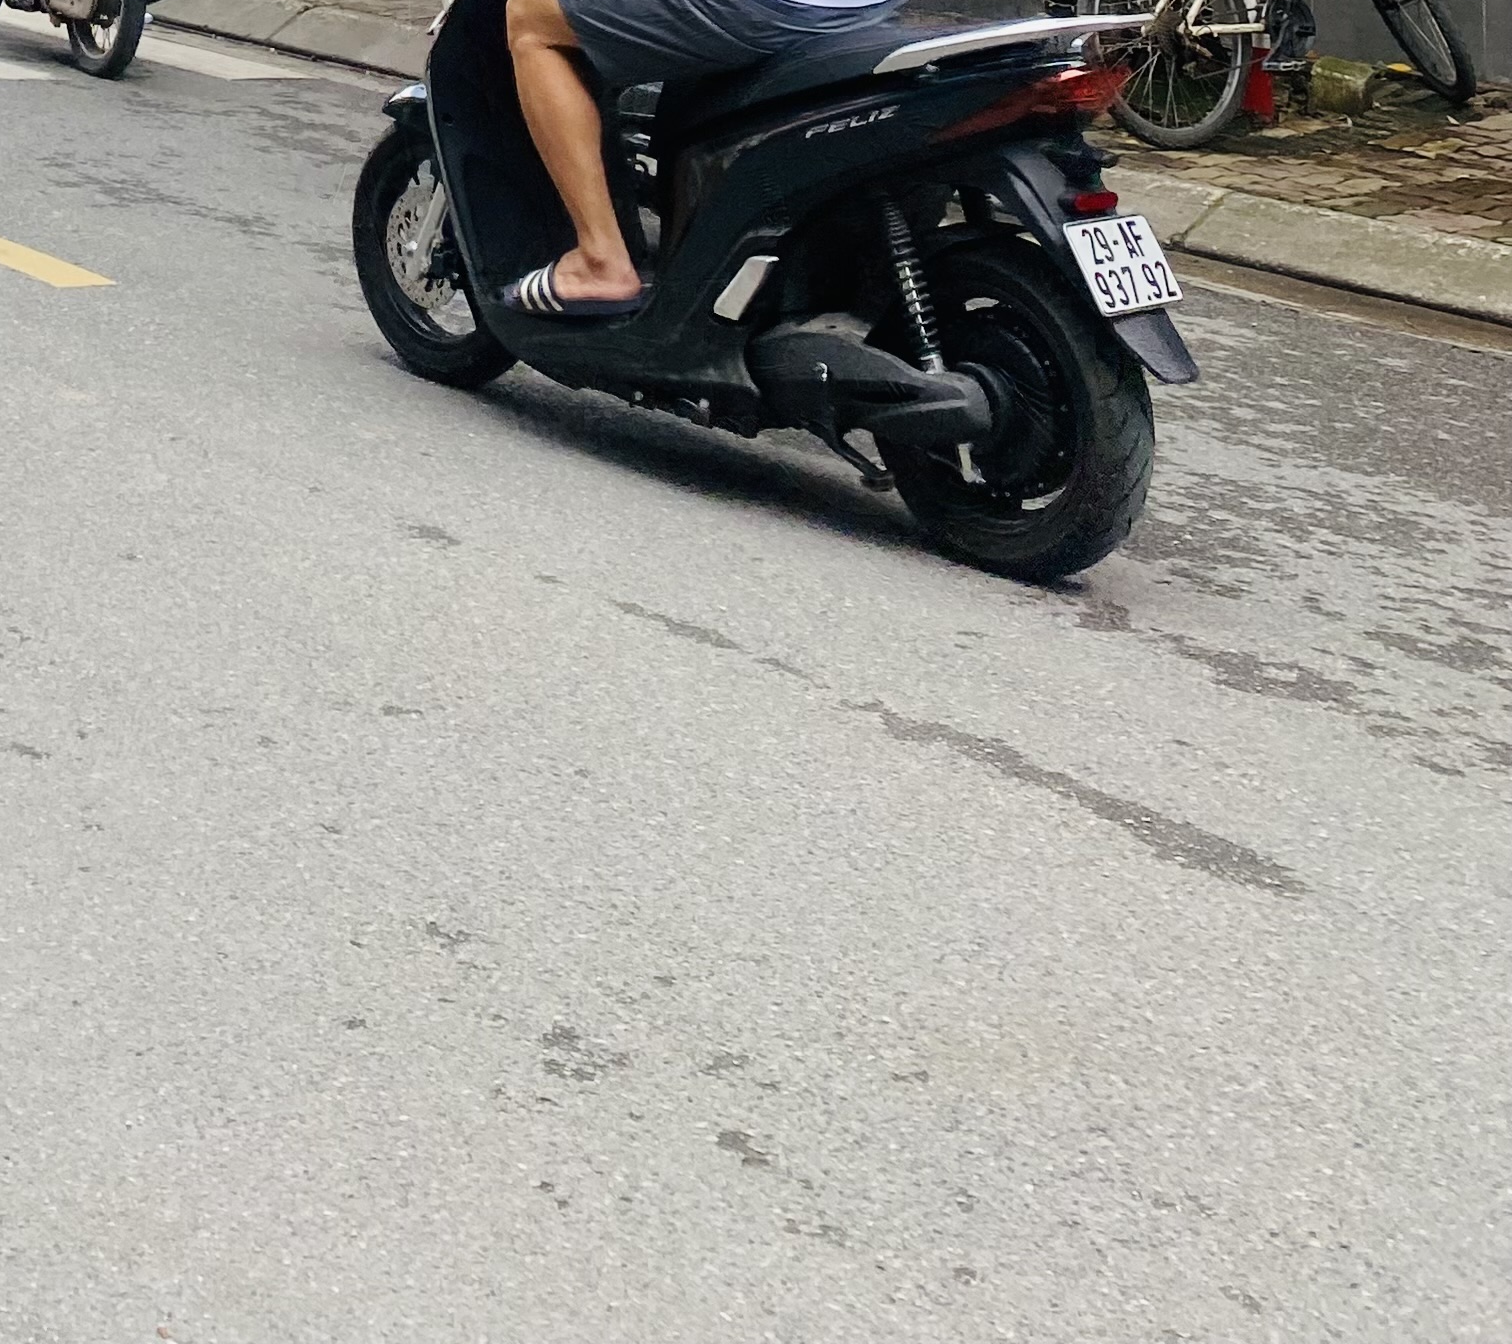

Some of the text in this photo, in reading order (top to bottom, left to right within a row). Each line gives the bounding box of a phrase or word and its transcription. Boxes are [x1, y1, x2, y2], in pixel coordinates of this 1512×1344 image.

[805, 104, 901, 139] FELIZ
[1082, 219, 1144, 266] 29-AF
[1094, 260, 1180, 310] 937.92
